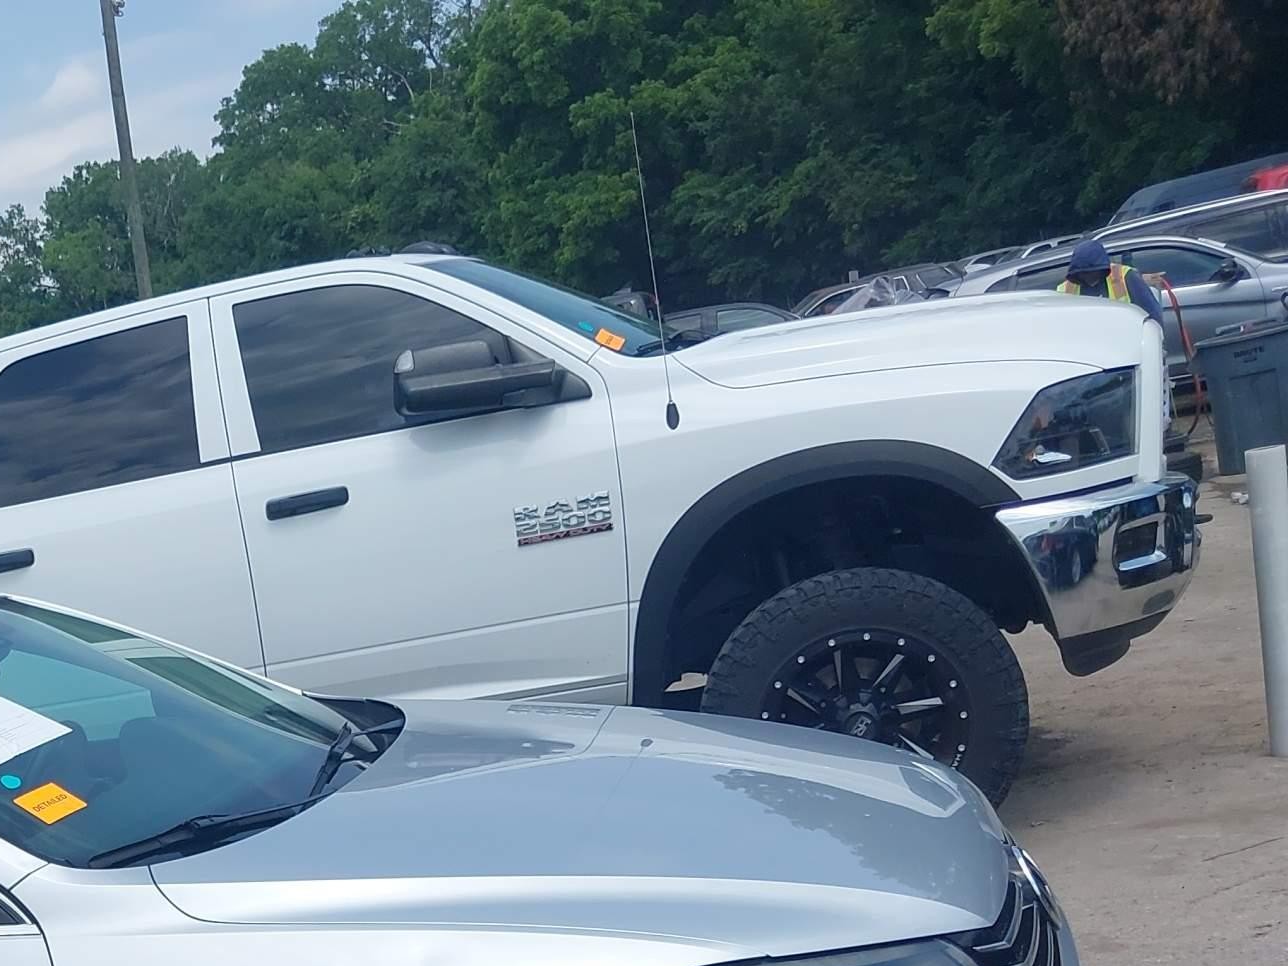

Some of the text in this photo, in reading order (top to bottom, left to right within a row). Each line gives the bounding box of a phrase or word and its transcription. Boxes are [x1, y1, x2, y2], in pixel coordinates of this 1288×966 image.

[513, 490, 611, 522] RAM
[515, 506, 612, 537] 2500
[519, 523, 611, 546] HEAVY DUTY
[33, 794, 68, 812] DETAILED
